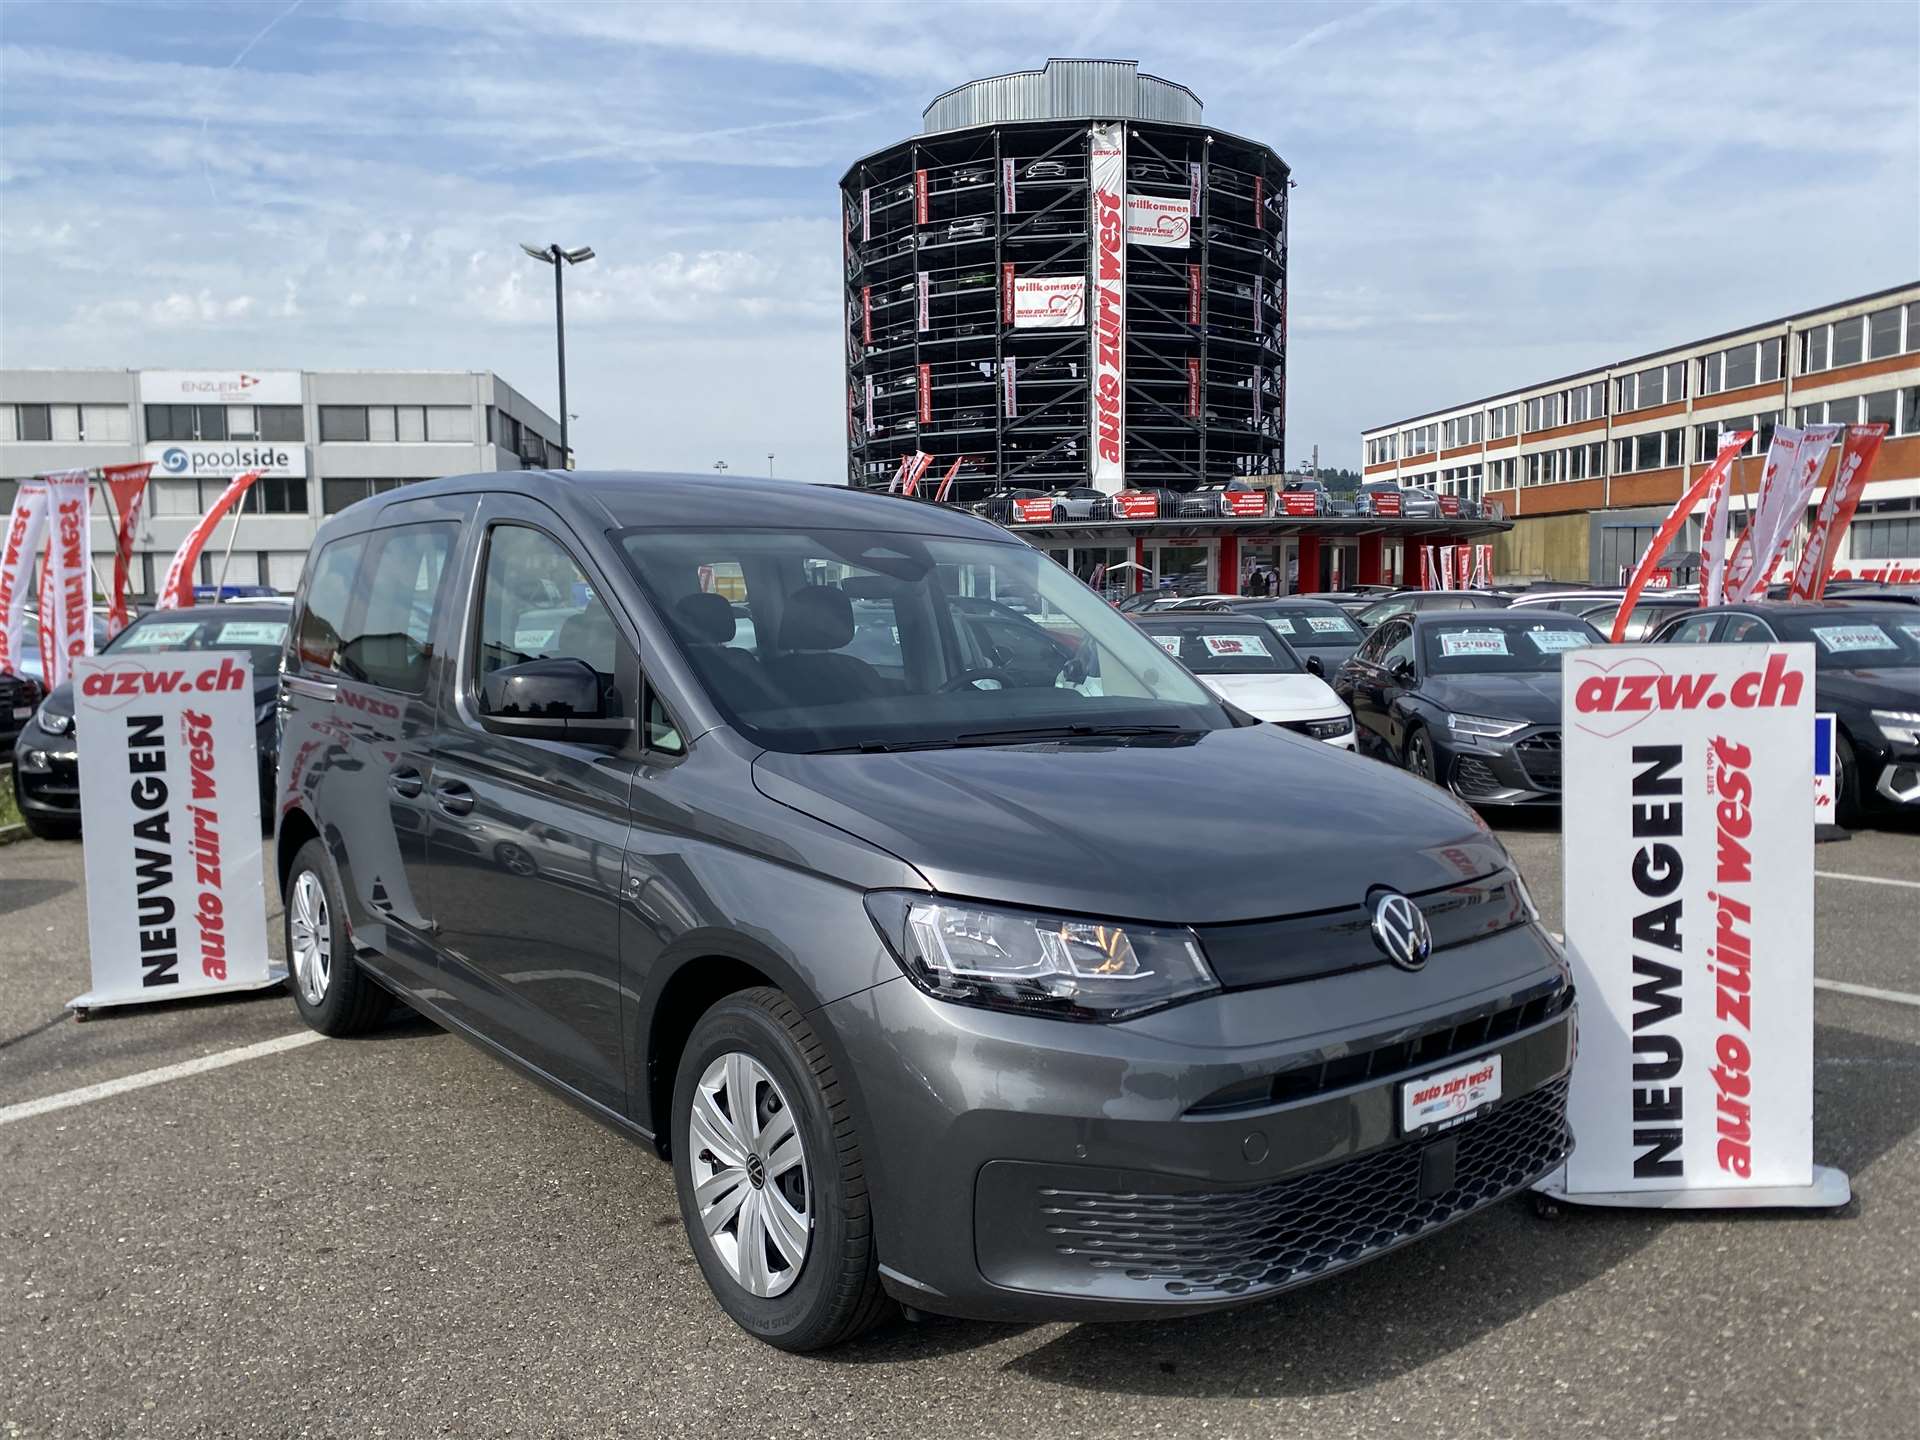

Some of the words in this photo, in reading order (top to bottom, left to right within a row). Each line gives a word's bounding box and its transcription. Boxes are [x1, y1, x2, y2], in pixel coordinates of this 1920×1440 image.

[1098, 187, 1121, 280] west
[1128, 199, 1189, 213] willkommen
[1016, 282, 1083, 292] willkommen
[1094, 284, 1121, 373] züri
[182, 381, 239, 392] ENZLER
[1094, 373, 1121, 464] auto
[192, 448, 289, 474] poolside
[83, 658, 246, 697] azw.ch
[1575, 653, 1805, 713] azw.ch
[182, 708, 217, 800] west
[126, 715, 179, 988] NEUWAGEN
[186, 804, 223, 890] züri
[1707, 734, 1752, 883] west
[194, 892, 228, 983] auto
[1632, 744, 1684, 1179] NEUWAGEN
[1707, 890, 1752, 1032] züri
[1412, 1084, 1441, 1106] auto
[1468, 1065, 1494, 1087] west
[1708, 1033, 1752, 1180] auto
